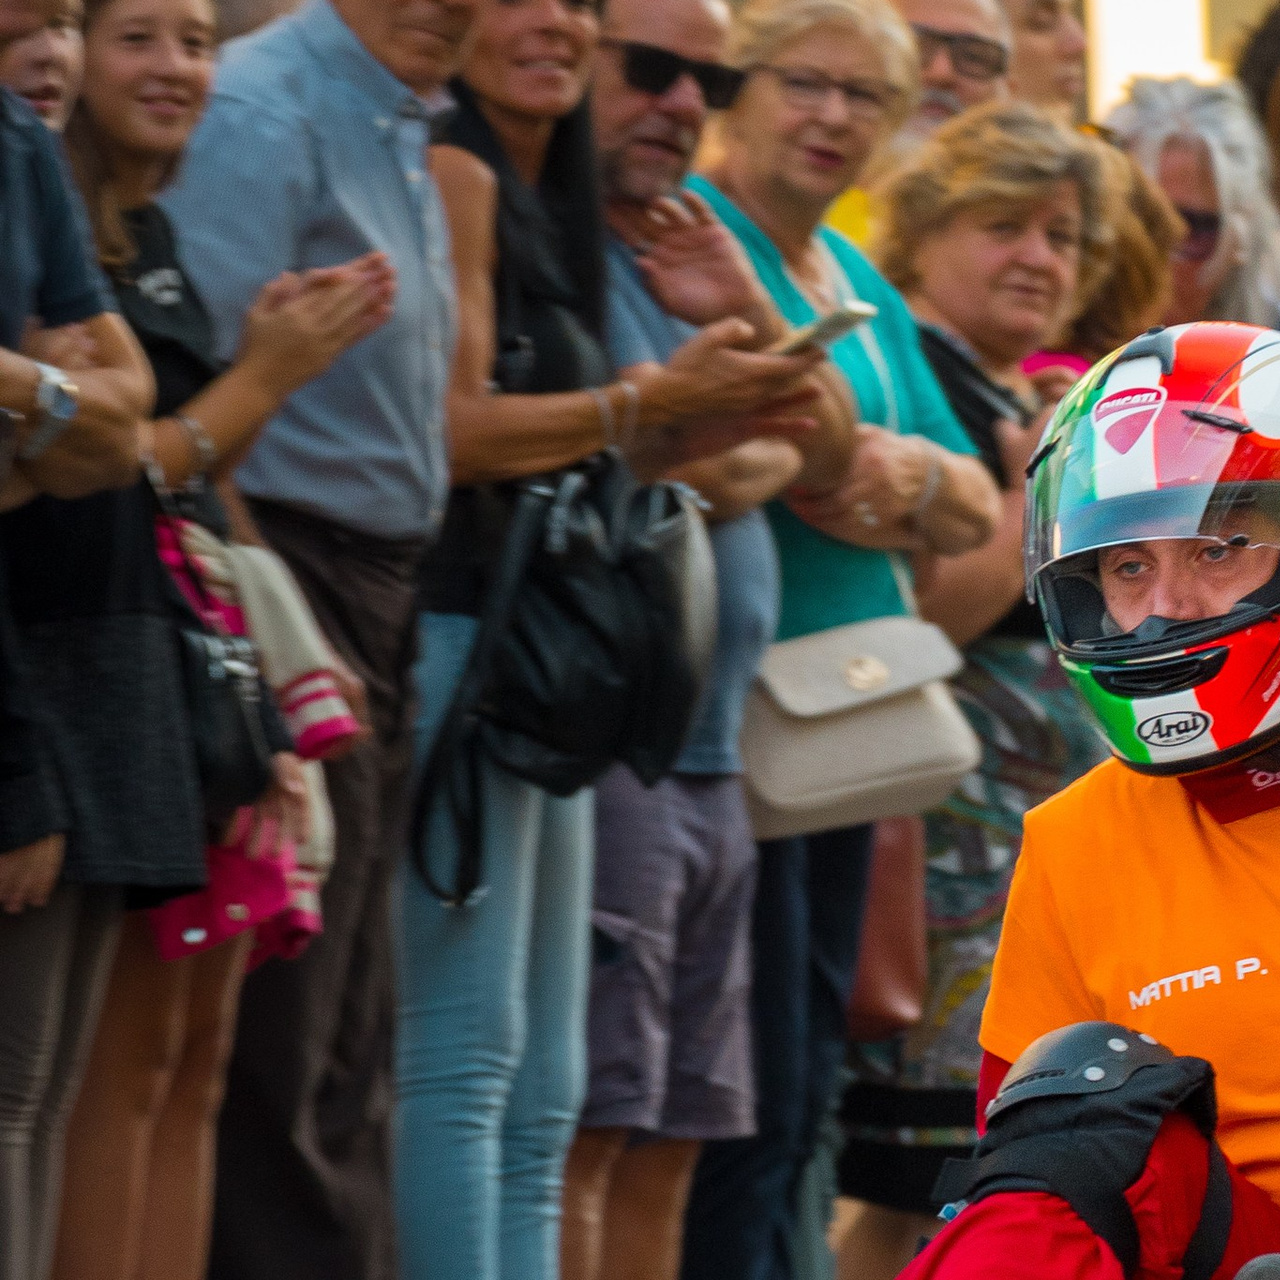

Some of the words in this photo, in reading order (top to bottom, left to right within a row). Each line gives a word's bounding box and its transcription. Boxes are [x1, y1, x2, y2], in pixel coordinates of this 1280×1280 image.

[1142, 710, 1201, 740] Arai
[1127, 964, 1222, 1011] MATTIA
[1234, 956, 1269, 981] P.
